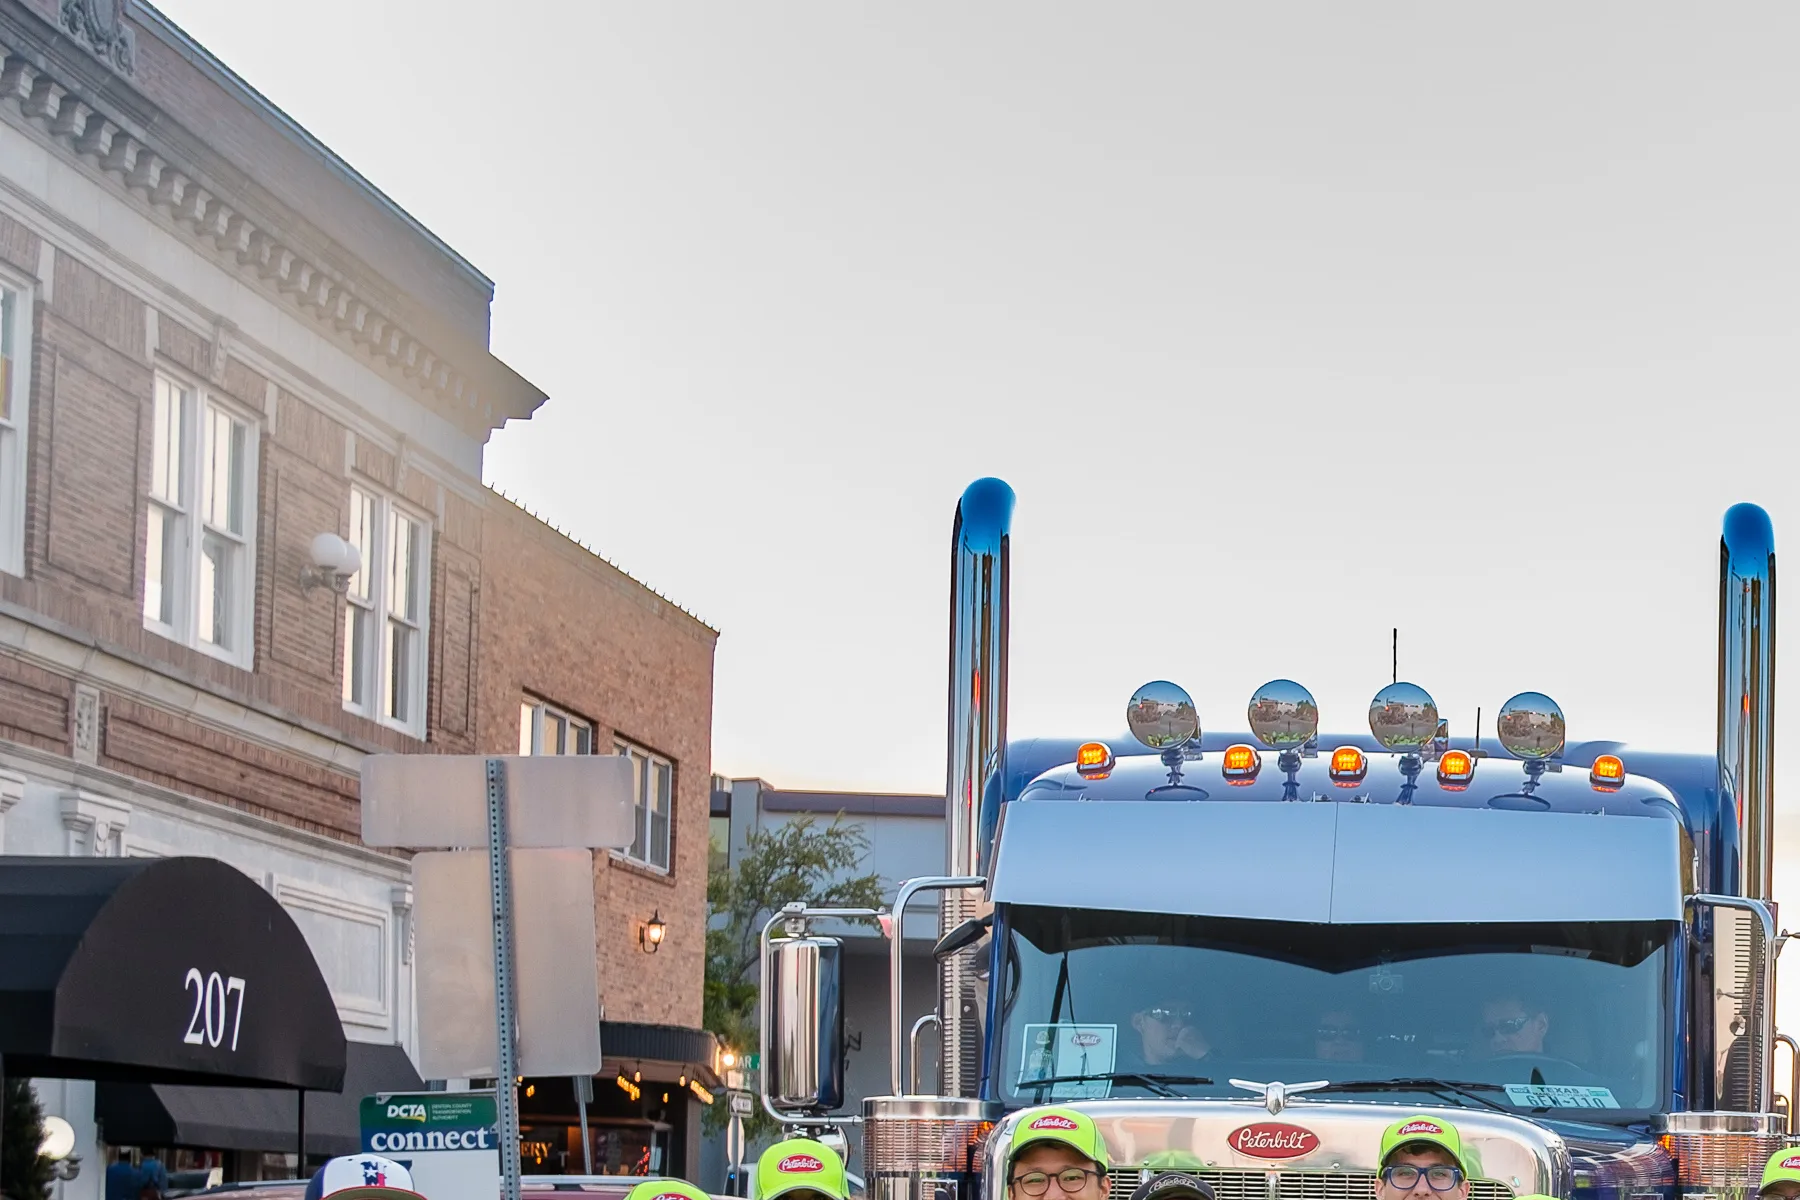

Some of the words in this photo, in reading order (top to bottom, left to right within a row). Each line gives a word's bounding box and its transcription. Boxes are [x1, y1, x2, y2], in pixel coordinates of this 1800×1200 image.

[184, 967, 246, 1052] 207
[1537, 1086, 1580, 1094] TEXAS
[387, 1104, 426, 1118] DCTA
[1033, 1118, 1073, 1129] Peterbilt
[1401, 1123, 1438, 1134] Peterbilt
[370, 1126, 489, 1151] connect
[1237, 1127, 1312, 1151] Peterbilt
[782, 1155, 820, 1169] Peterbilt
[1154, 1177, 1192, 1190] Peterbilt
